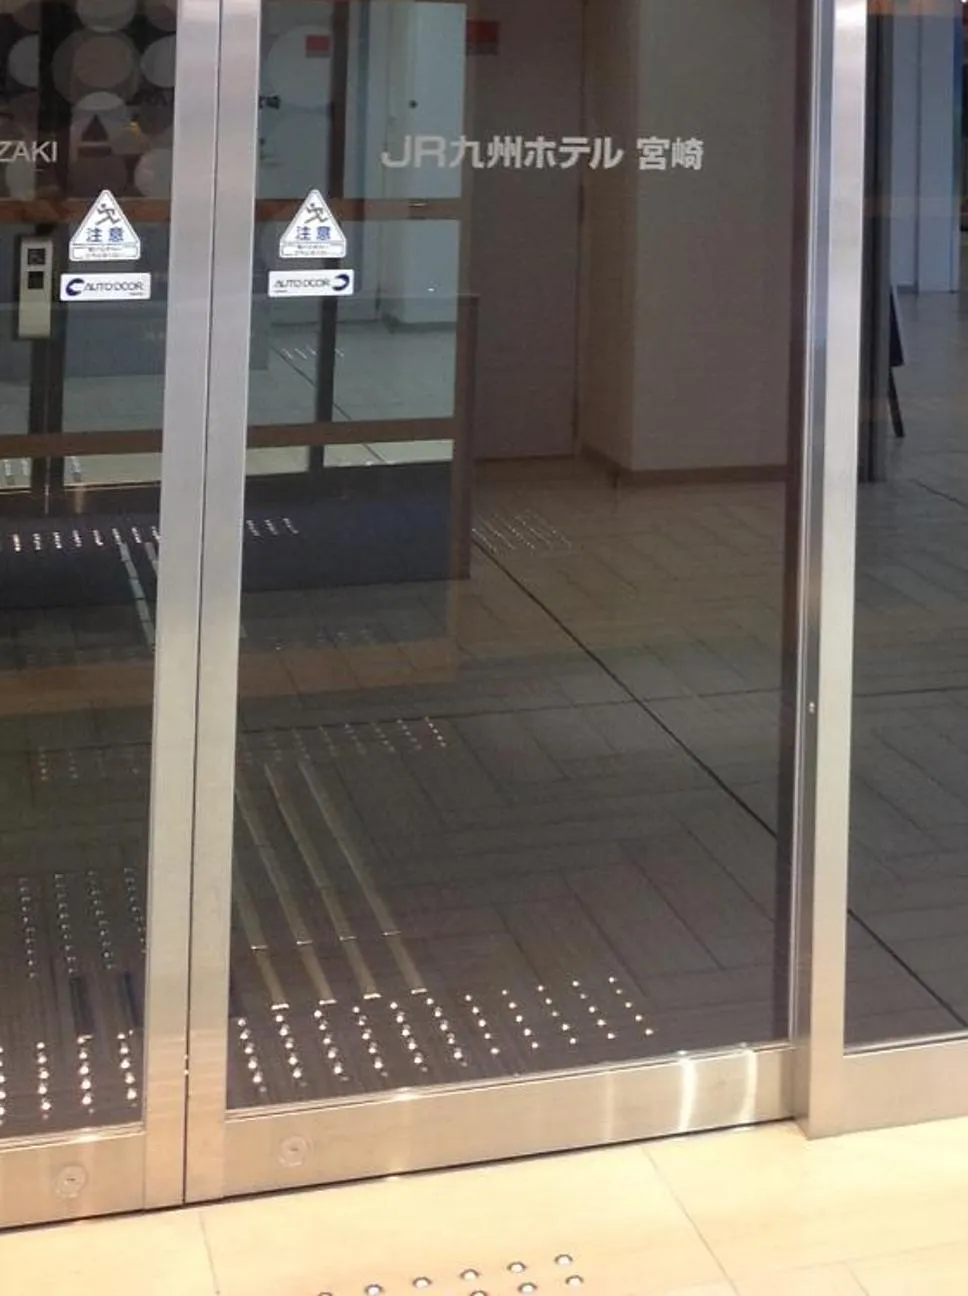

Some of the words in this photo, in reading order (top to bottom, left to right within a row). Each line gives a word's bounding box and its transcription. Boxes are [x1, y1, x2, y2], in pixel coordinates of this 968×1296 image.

[380, 134, 624, 170] JR九州ホテル
[636, 135, 705, 171] 宮崎
[86, 226, 125, 243] 注意
[295, 225, 331, 241] 注意
